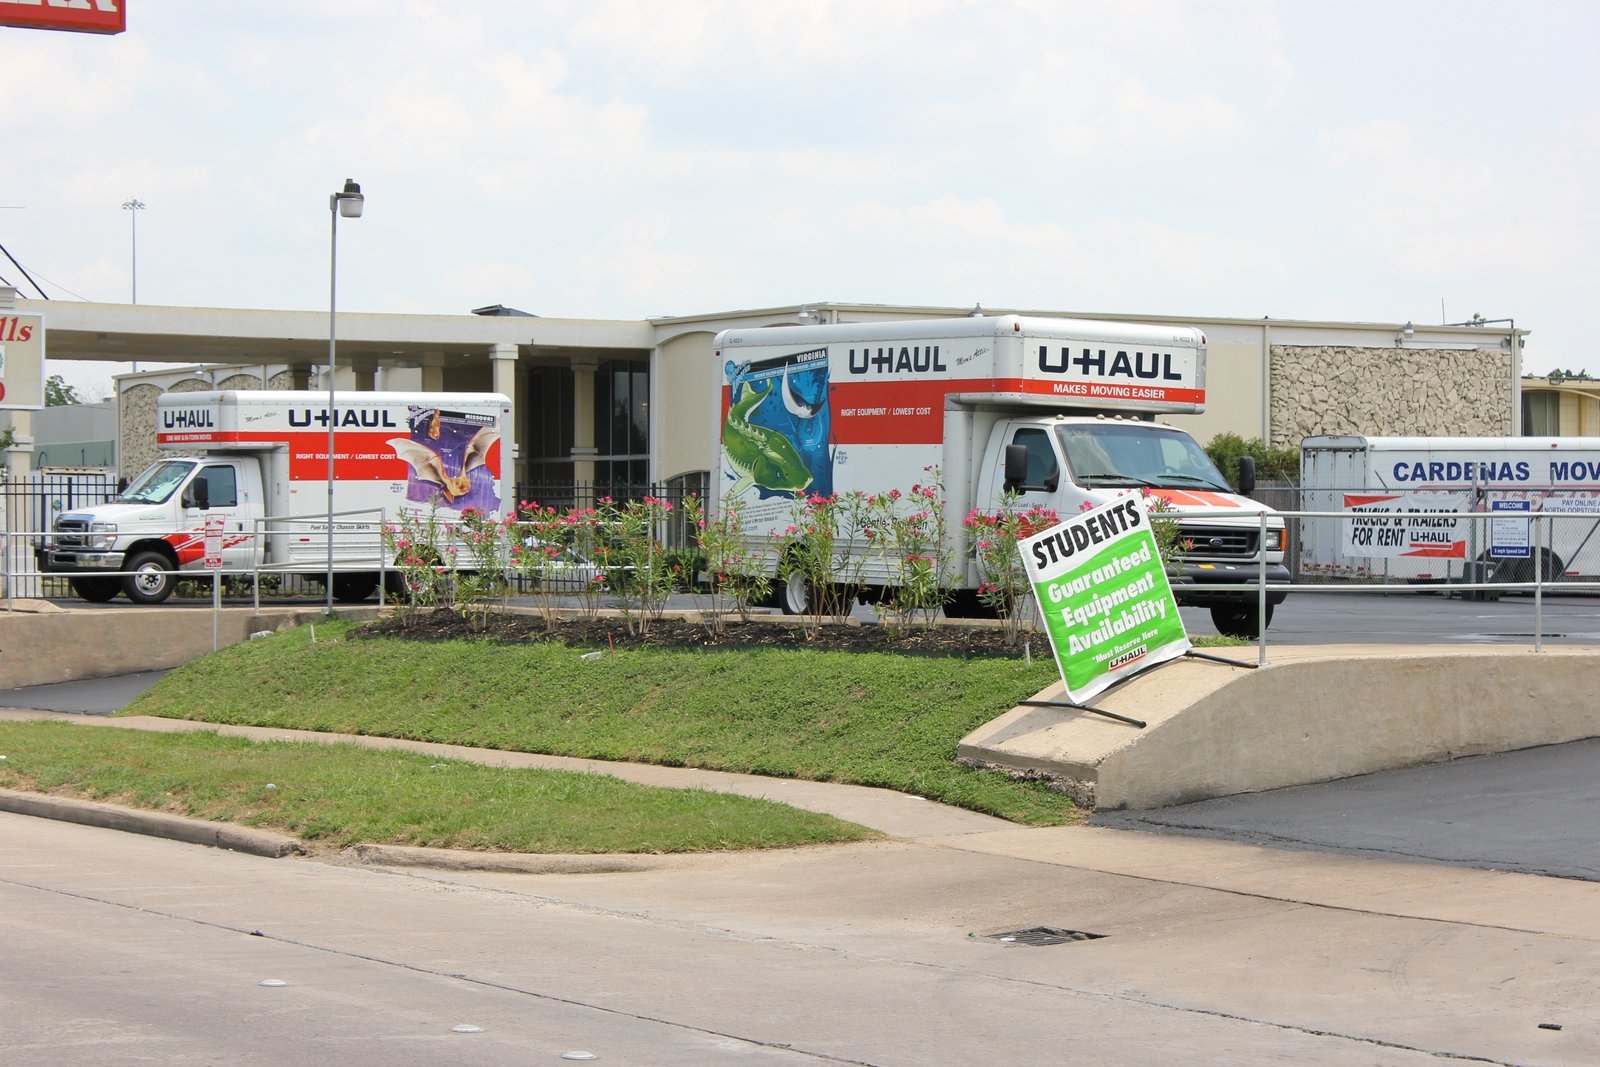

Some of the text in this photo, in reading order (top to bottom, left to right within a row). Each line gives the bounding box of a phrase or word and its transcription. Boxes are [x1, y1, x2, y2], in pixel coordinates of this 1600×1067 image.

[796, 349, 826, 363] VIRGINIA
[848, 346, 947, 375] U-HAUL
[1038, 345, 1182, 381] U-HAUL
[1053, 383, 1165, 399] MAKES MOVING EASIER
[163, 410, 214, 428] U-HAUL
[288, 409, 397, 428] U-HAUL
[465, 414, 494, 422] MISSOURI
[840, 408, 856, 417] RIGHT
[857, 407, 886, 416] EQUIPMENT
[892, 407, 914, 416] LOWEST
[916, 407, 932, 415] COST
[1393, 461, 1530, 482] CARDENAS
[1498, 502, 1524, 510] WELCOME
[1032, 499, 1141, 570] STUDENTS
[1351, 527, 1406, 546] FOR RENT
[1410, 531, 1452, 543] U-HAUL
[1047, 540, 1152, 604] Guaranteed
[1060, 571, 1155, 628] Equipment
[1113, 637, 1140, 656] Reserve
[1142, 628, 1159, 641] Here
[1109, 646, 1146, 668] U-HAUL
